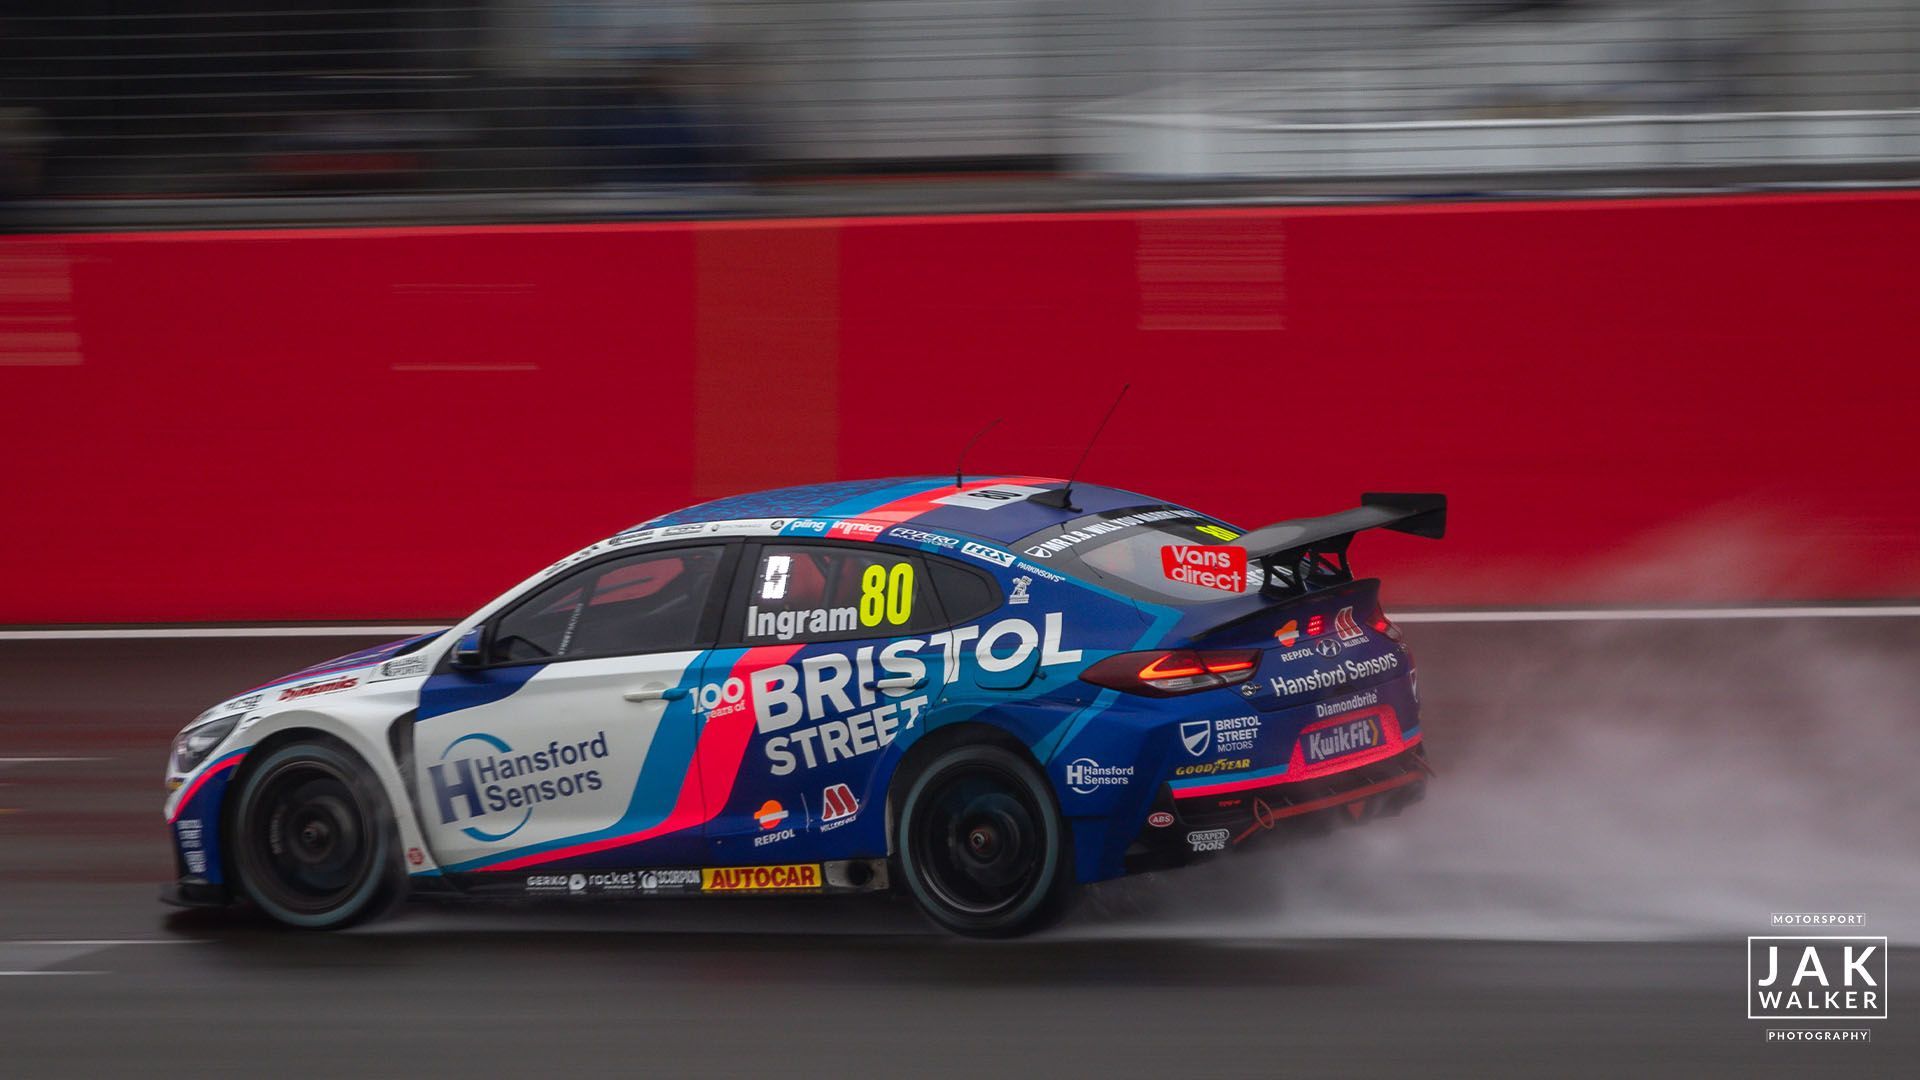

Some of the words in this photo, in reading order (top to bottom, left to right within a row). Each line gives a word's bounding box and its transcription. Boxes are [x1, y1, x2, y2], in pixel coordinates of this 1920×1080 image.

[1041, 534, 1071, 552] MR
[1065, 527, 1096, 543] D.B.
[1086, 521, 1123, 535] WILL
[1171, 545, 1231, 568] Vans
[1171, 564, 1241, 592] direct
[748, 606, 858, 640] Ingram
[859, 562, 914, 627] 80
[1281, 648, 1314, 662] REPSOL
[750, 612, 1082, 734] BRISTOL
[1270, 664, 1346, 697] Hansford
[1345, 652, 1398, 680] Sensors
[688, 677, 745, 714] 100
[1316, 691, 1377, 717] Diamondbrite
[704, 705, 734, 723] years
[733, 700, 746, 712] of
[1215, 715, 1262, 731] BRISTOL
[765, 695, 928, 775] STREET
[1217, 728, 1258, 743] STREET
[1217, 740, 1254, 753] MOTORS
[476, 730, 608, 784] Hansford
[1083, 765, 1134, 775] Hansford
[1083, 775, 1129, 785] Sensors
[486, 769, 602, 812] Sensors
[754, 829, 796, 848] REPSOL
[1191, 831, 1227, 842] DRAPER
[1192, 841, 1226, 852] Tools
[589, 872, 636, 886] rocket
[710, 865, 815, 889] AUTOCAR
